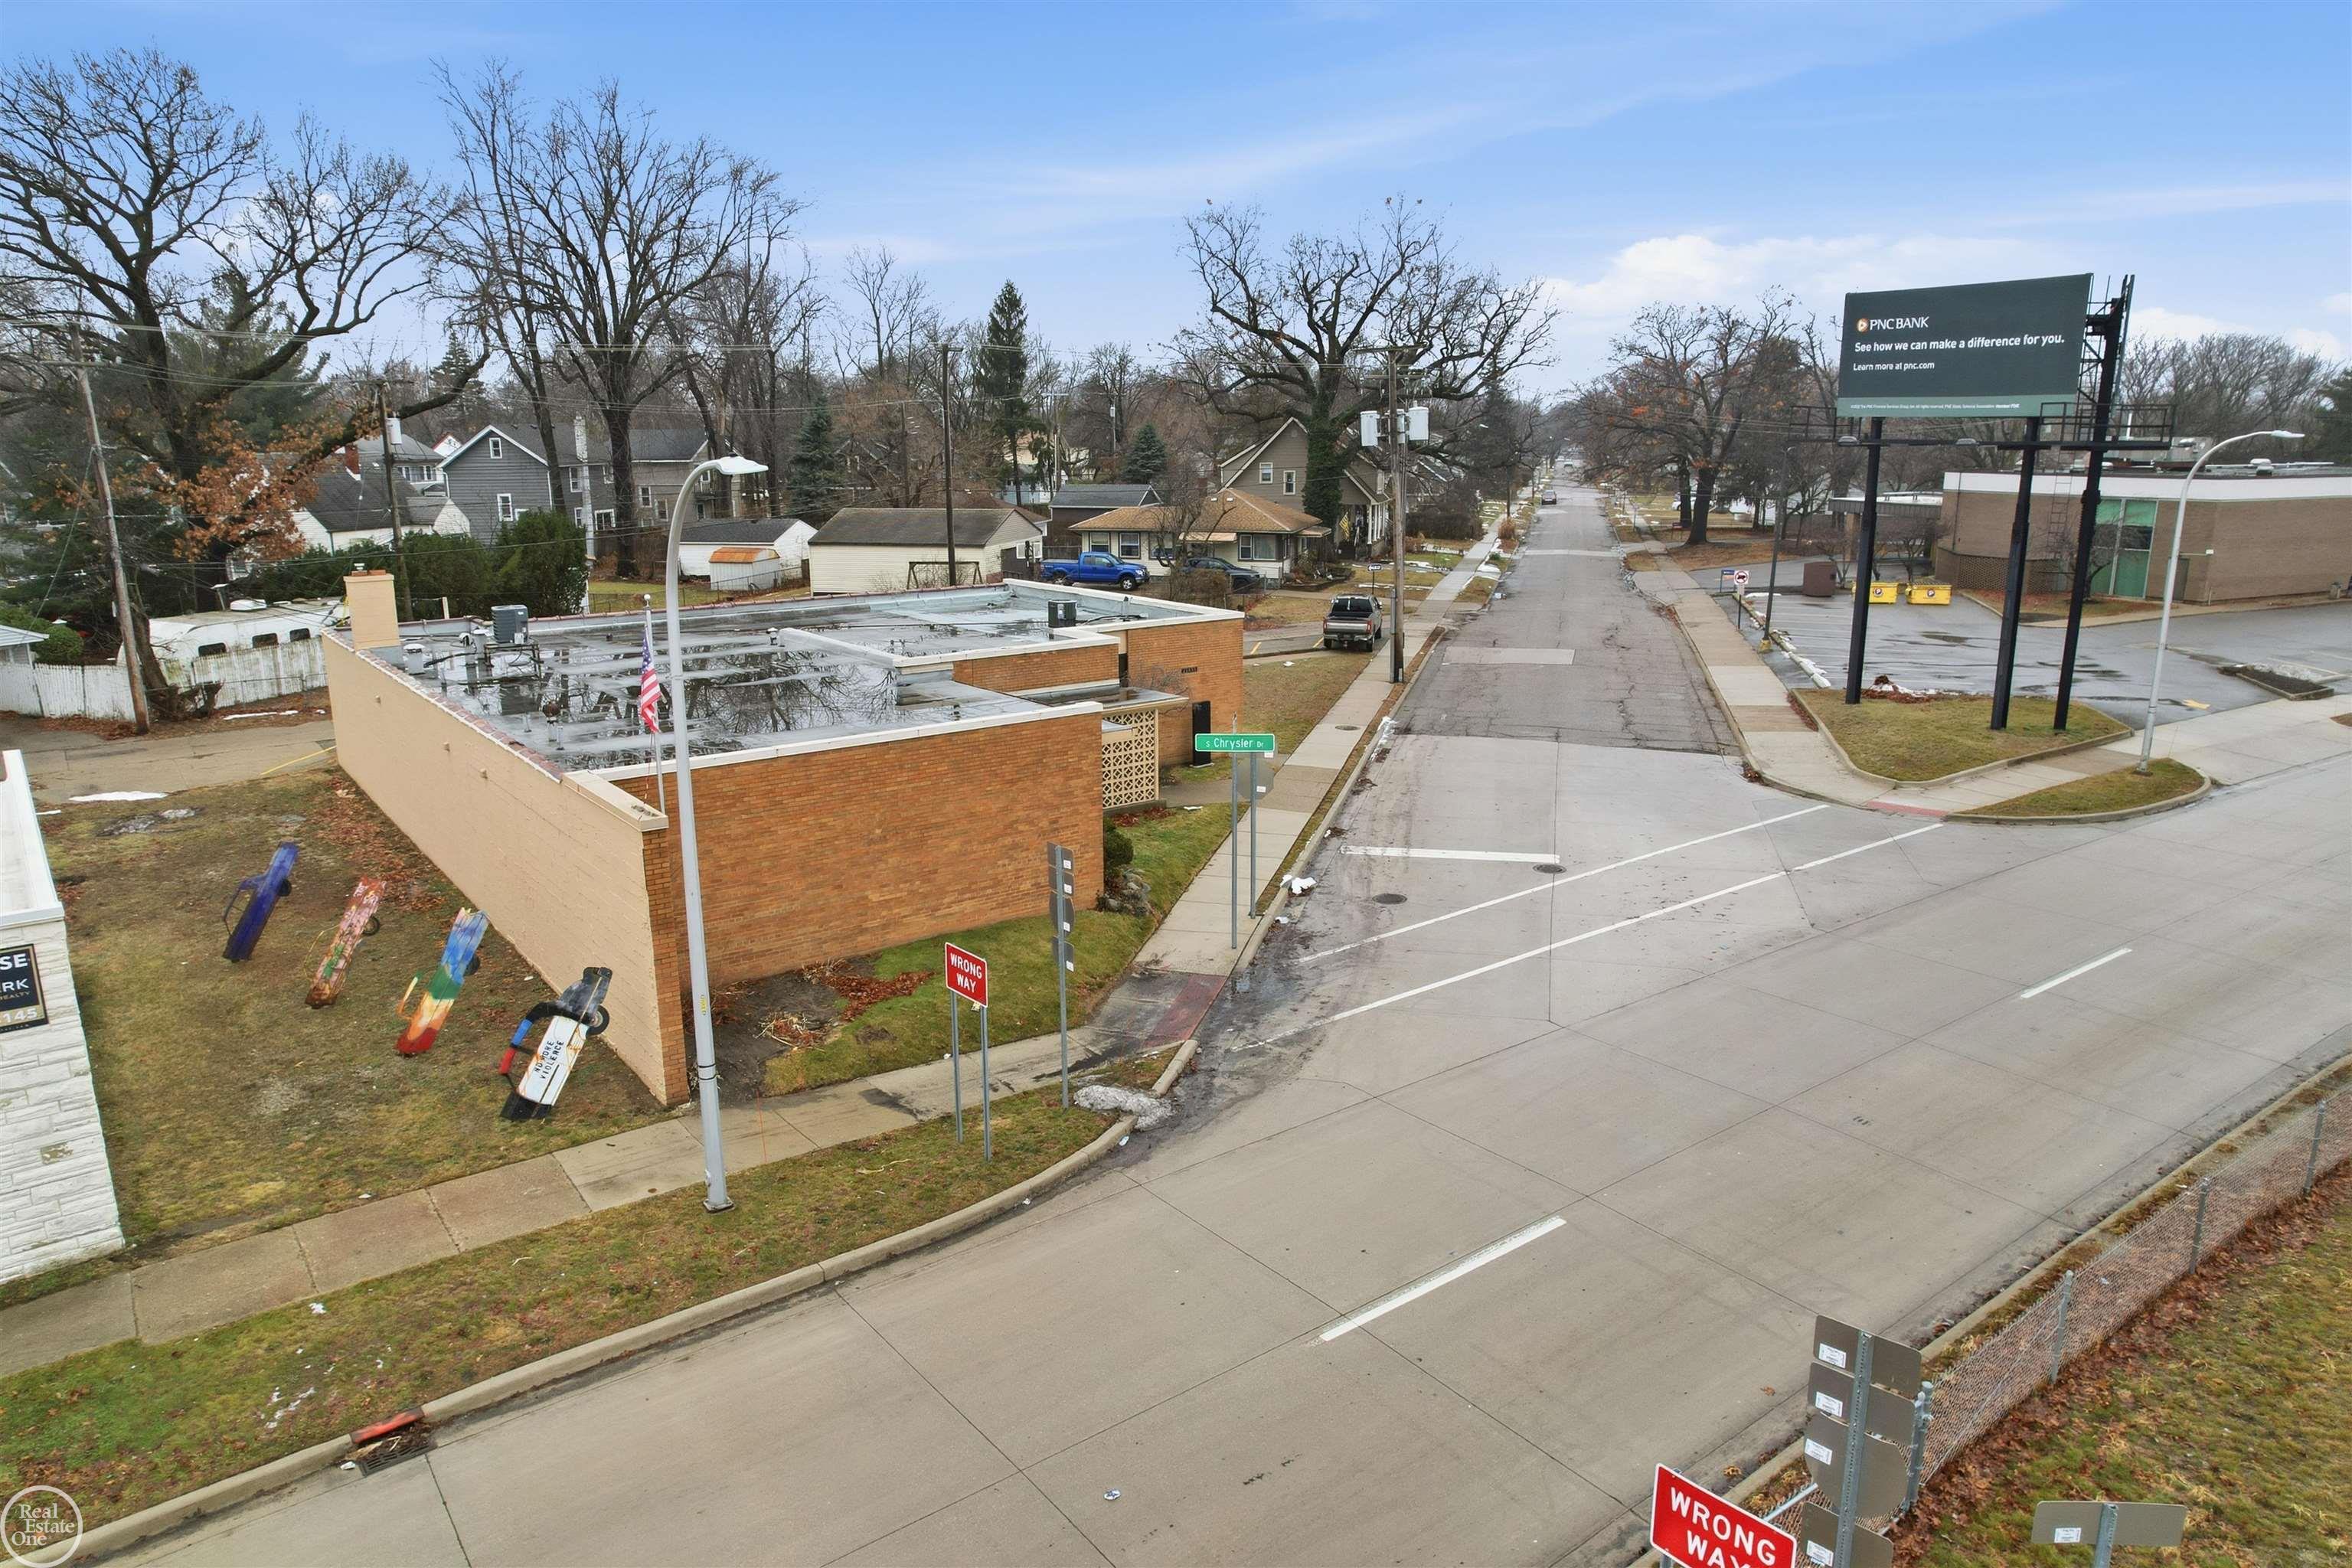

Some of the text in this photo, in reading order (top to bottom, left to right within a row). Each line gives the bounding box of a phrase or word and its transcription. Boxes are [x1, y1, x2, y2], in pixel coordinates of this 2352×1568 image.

[1870, 316, 1929, 331] PNC BANK
[1854, 342, 1871, 352] See
[1873, 341, 1892, 351] how
[1910, 341, 1927, 350] can
[1929, 338, 1956, 349] make
[1958, 340, 1965, 348] a
[1968, 336, 2020, 348] difference
[2023, 334, 2040, 345] for
[2041, 335, 2065, 347] you.
[1853, 362, 1873, 371] Learn
[1895, 362, 1903, 371] at
[1903, 362, 1935, 371] pnc.com
[1214, 737, 1253, 750] Chrysler
[950, 952, 982, 979] WRONG
[0, 978, 30, 992] RK
[956, 972, 976, 993] WAY
[0, 1008, 38, 1023] 145
[1671, 1487, 1776, 1566] WRONG
